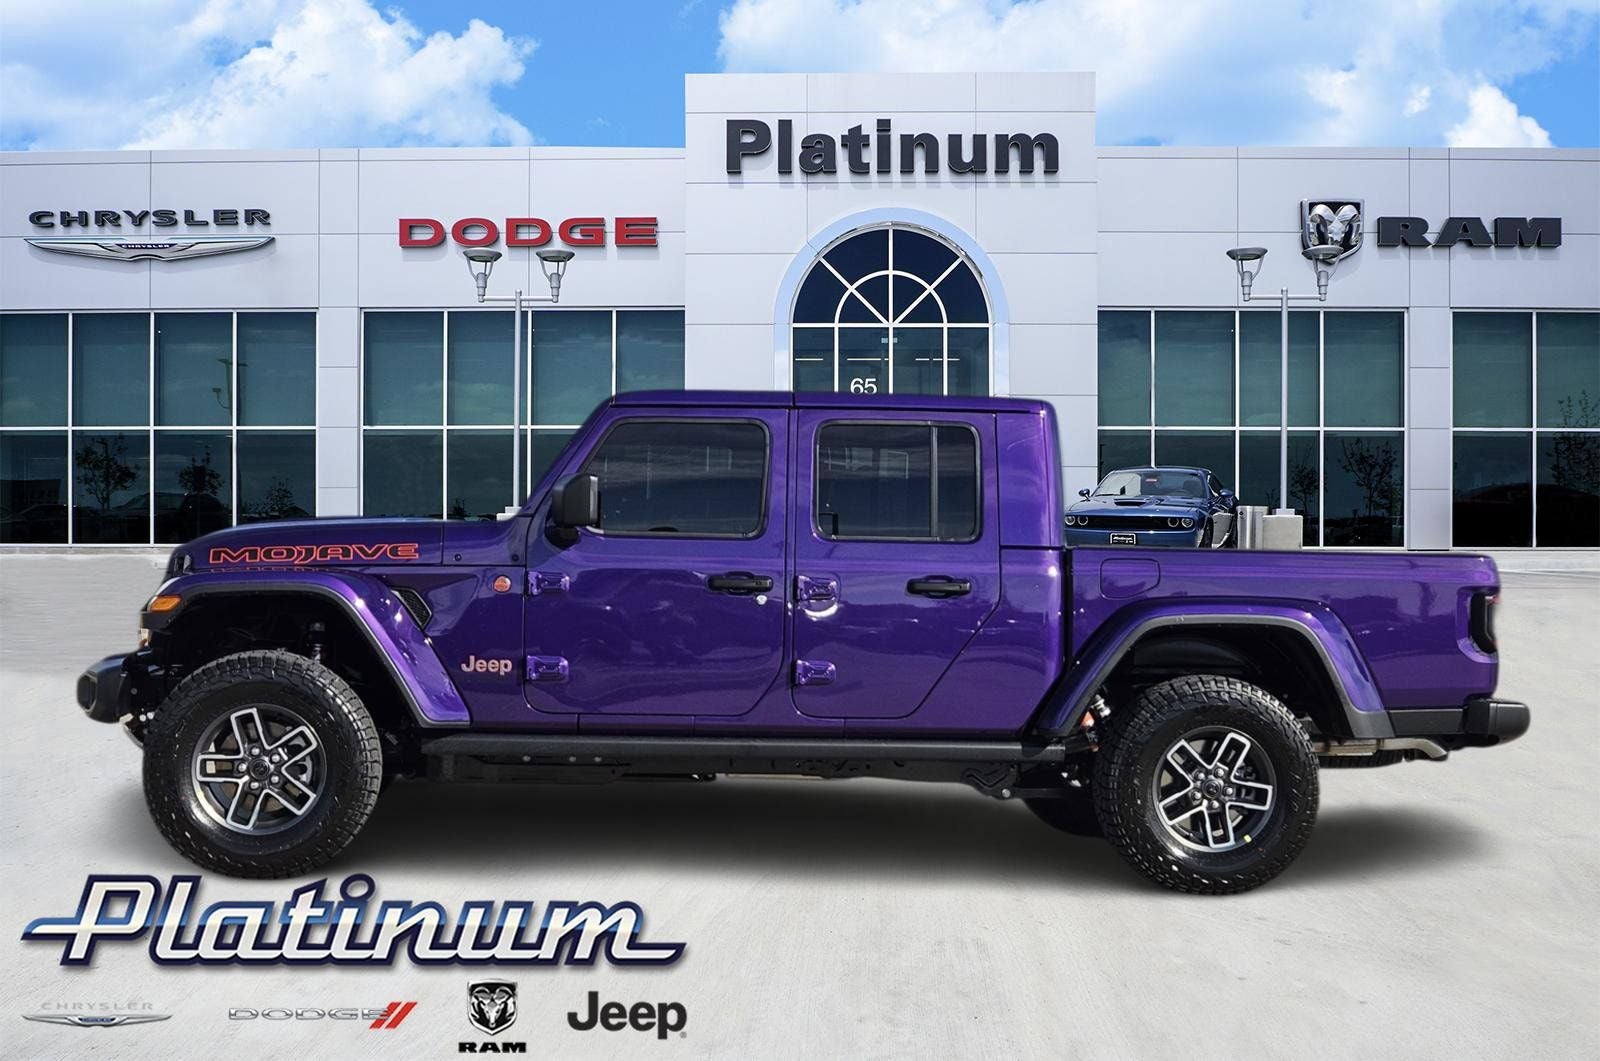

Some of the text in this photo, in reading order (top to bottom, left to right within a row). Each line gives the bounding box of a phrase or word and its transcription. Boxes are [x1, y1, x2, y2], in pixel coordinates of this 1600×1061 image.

[726, 119, 1059, 175] Platinum
[29, 209, 271, 227] CHRYSLER
[398, 217, 659, 248] DODGE
[1377, 216, 1562, 248] RAM
[850, 377, 878, 395] 65
[209, 543, 419, 564] MOJAVE
[461, 655, 513, 676] Jeep
